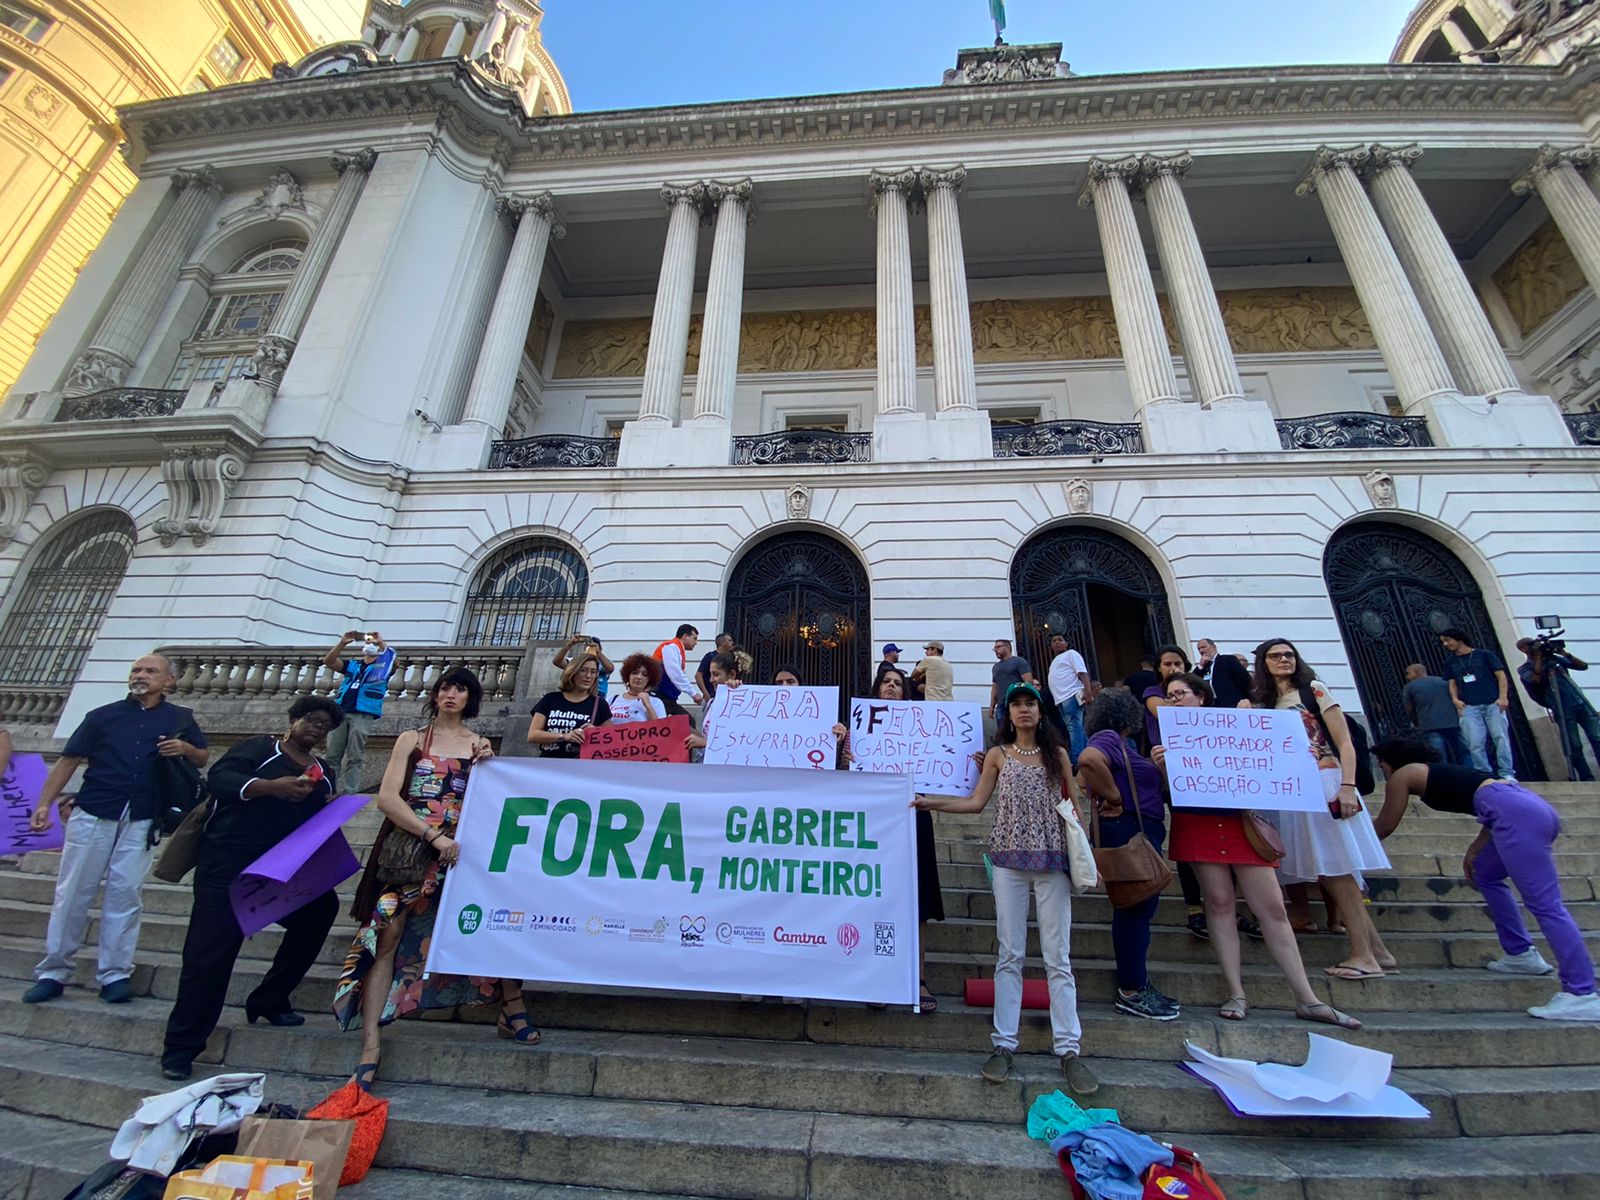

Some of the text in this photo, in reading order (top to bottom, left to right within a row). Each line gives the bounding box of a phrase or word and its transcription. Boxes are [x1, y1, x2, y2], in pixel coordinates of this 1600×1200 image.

[720, 688, 819, 719] FORA
[549, 710, 591, 723] Mulher,
[867, 704, 954, 738] FORA
[1174, 711, 1273, 730] LUGAR DE
[1168, 734, 1295, 754] ESTUPRADOR É
[1182, 755, 1274, 772] NA CADEIA!
[1172, 774, 1301, 798] CASSAÇÃO JÁ!
[725, 805, 878, 850] GABRIEL
[488, 797, 704, 894] FORA,
[718, 856, 881, 898] MONTEIRO!
[461, 910, 478, 920] MEU
[463, 920, 477, 930] RIO
[530, 924, 577, 933] FEMINICIDADE
[875, 923, 894, 931] DEIXA
[773, 926, 827, 945] Camtra
[876, 931, 893, 939] ELA
[876, 945, 893, 954] PAZ
